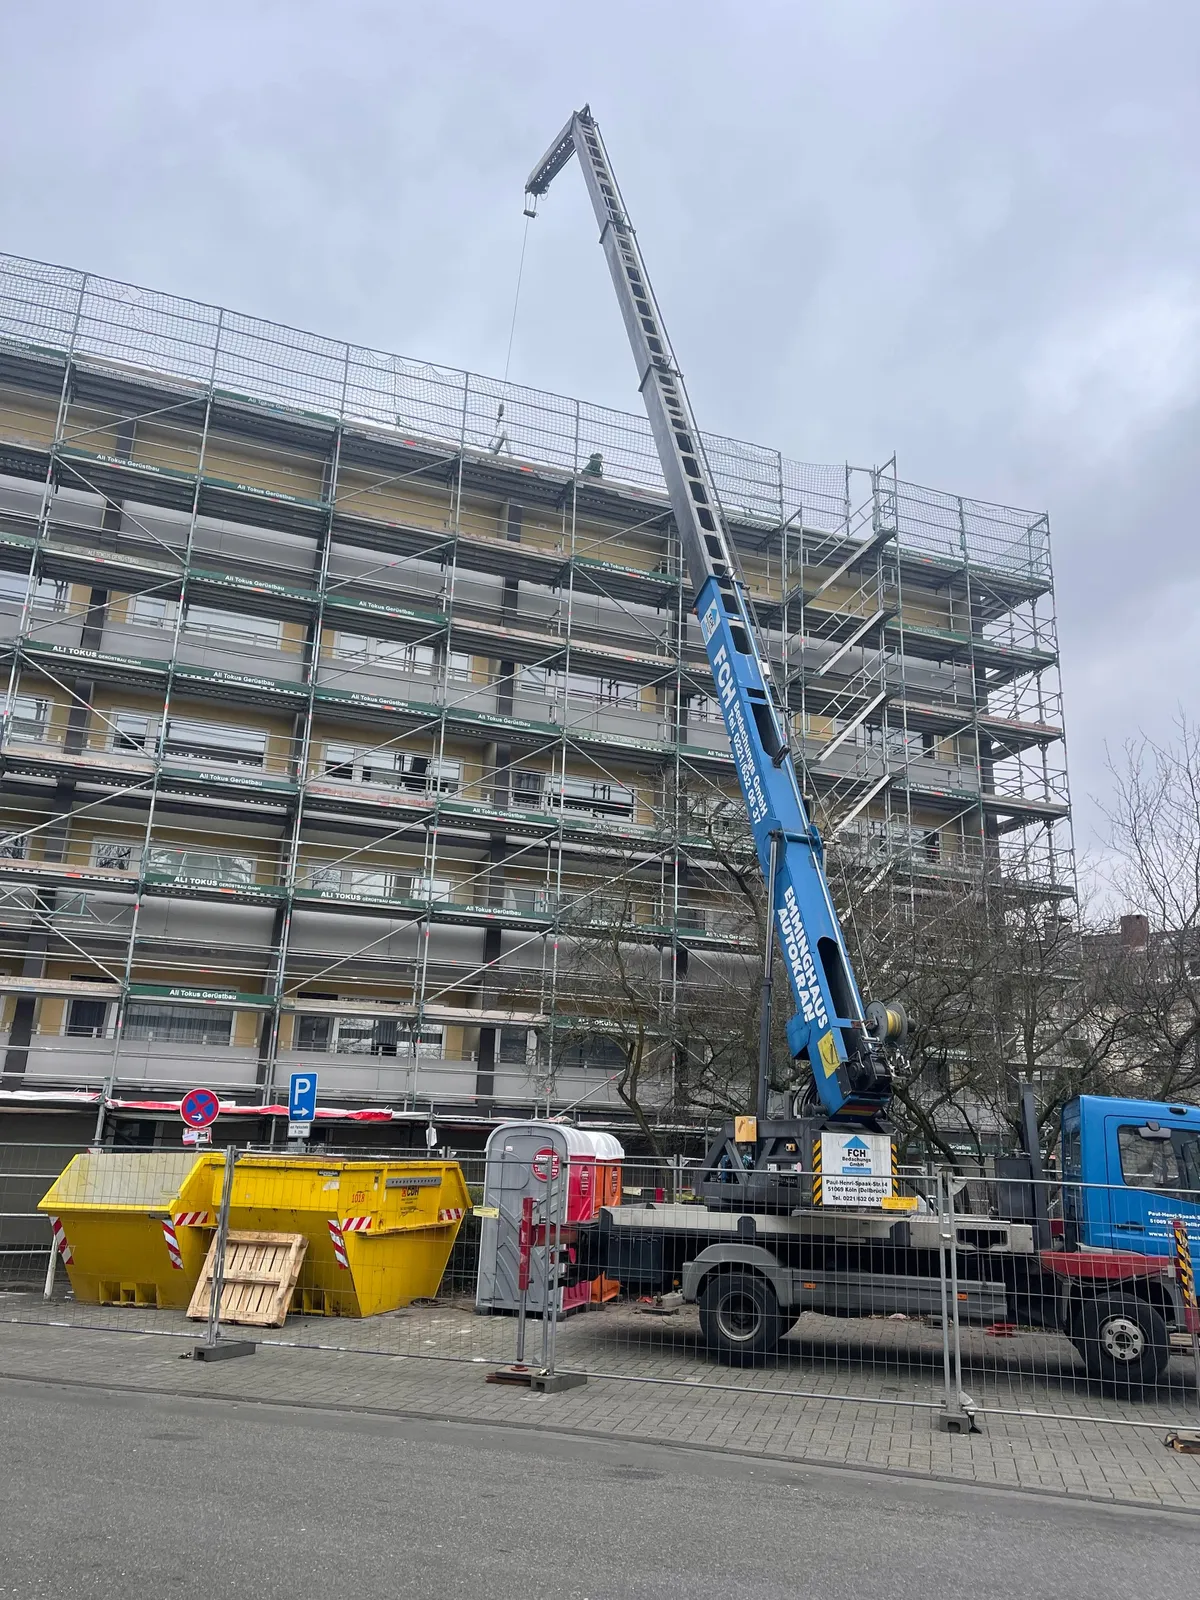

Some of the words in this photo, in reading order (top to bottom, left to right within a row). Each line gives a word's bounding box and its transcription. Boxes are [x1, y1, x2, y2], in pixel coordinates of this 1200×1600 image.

[69, 648, 97, 657] TOKUS
[714, 644, 736, 709] FCH
[753, 775, 768, 817] GmbH
[753, 807, 762, 824] 37
[190, 878, 217, 886] TOKUS
[778, 908, 815, 1022] AUTOKRAN
[784, 885, 828, 1029] EMMINGHAUS
[294, 1078, 310, 1105] P
[848, 1149, 866, 1157] FCH
